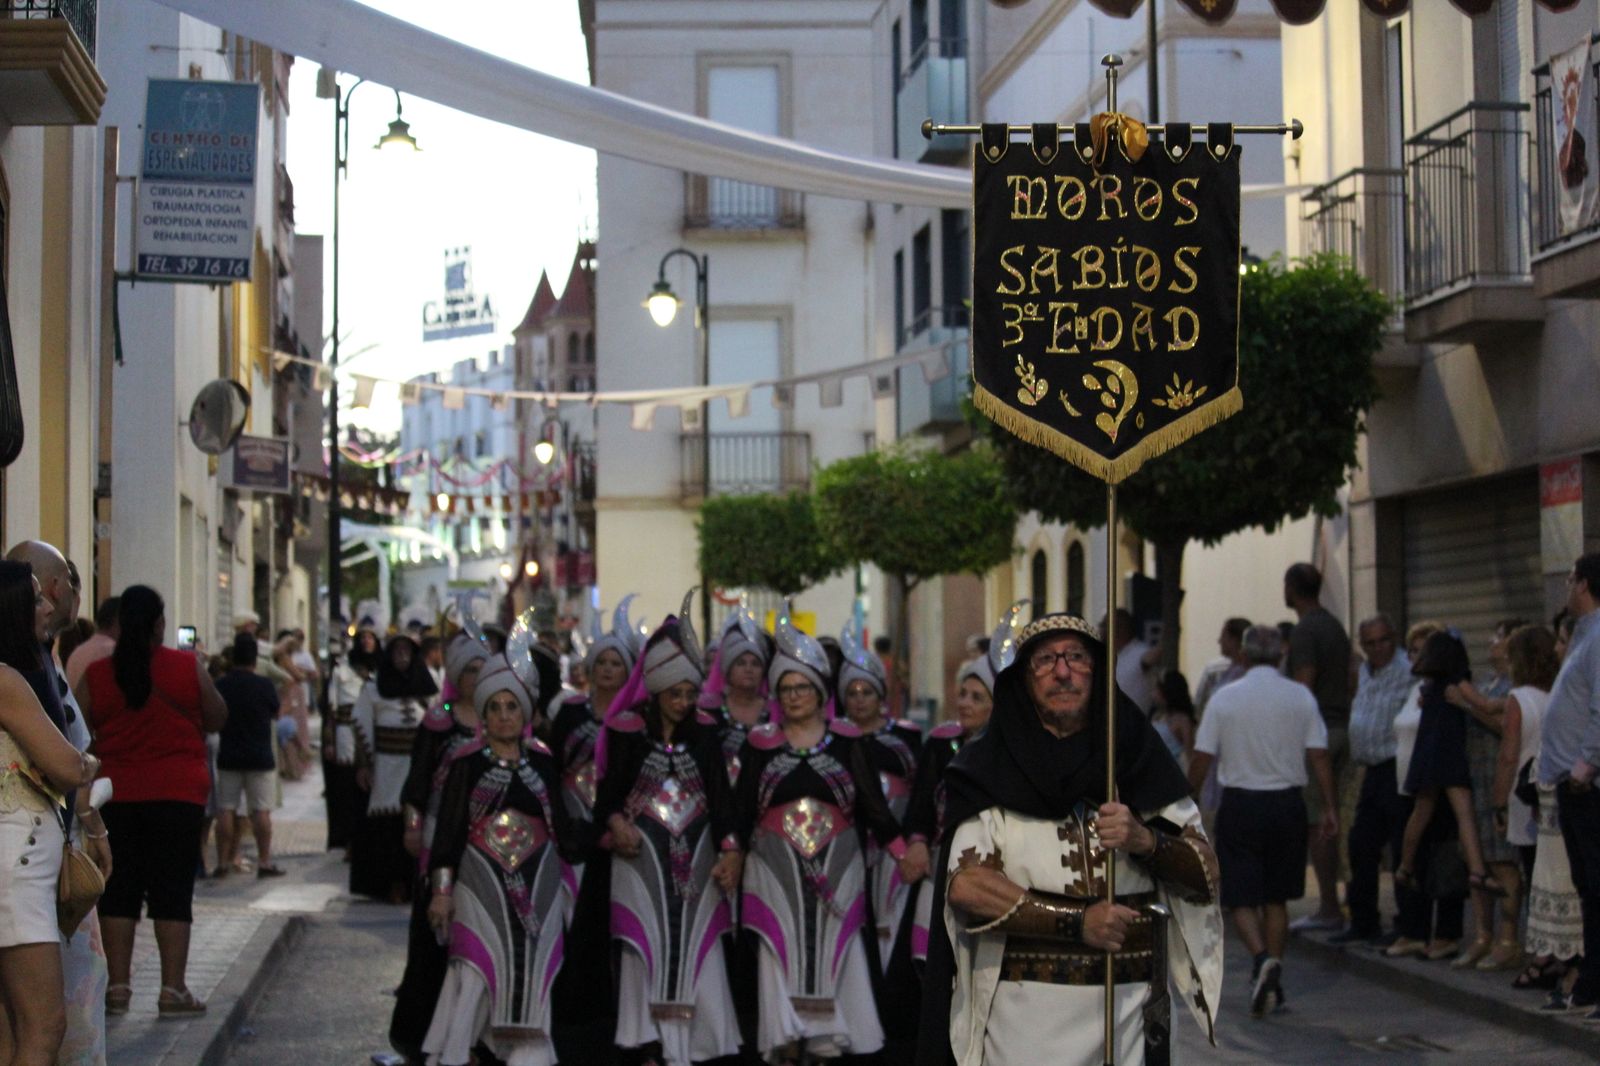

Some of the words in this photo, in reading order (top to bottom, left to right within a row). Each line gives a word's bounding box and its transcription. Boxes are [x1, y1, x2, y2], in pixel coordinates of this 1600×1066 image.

[150, 131, 222, 146] CENTRO
[229, 135, 249, 147] DE
[148, 149, 252, 172] ESPECIALIDADES
[150, 186, 194, 198] CIRUGIA
[197, 188, 245, 200] PLASTICA
[1006, 174, 1200, 226] MOROS
[152, 201, 242, 215] TRAUMATOLOGIA
[143, 215, 202, 227] ORTOPEDIA
[205, 219, 249, 230] INFANTIL
[153, 231, 238, 244] REHABILITACION
[177, 258, 198, 273] 39
[203, 259, 221, 276] 16
[227, 260, 245, 276] 16
